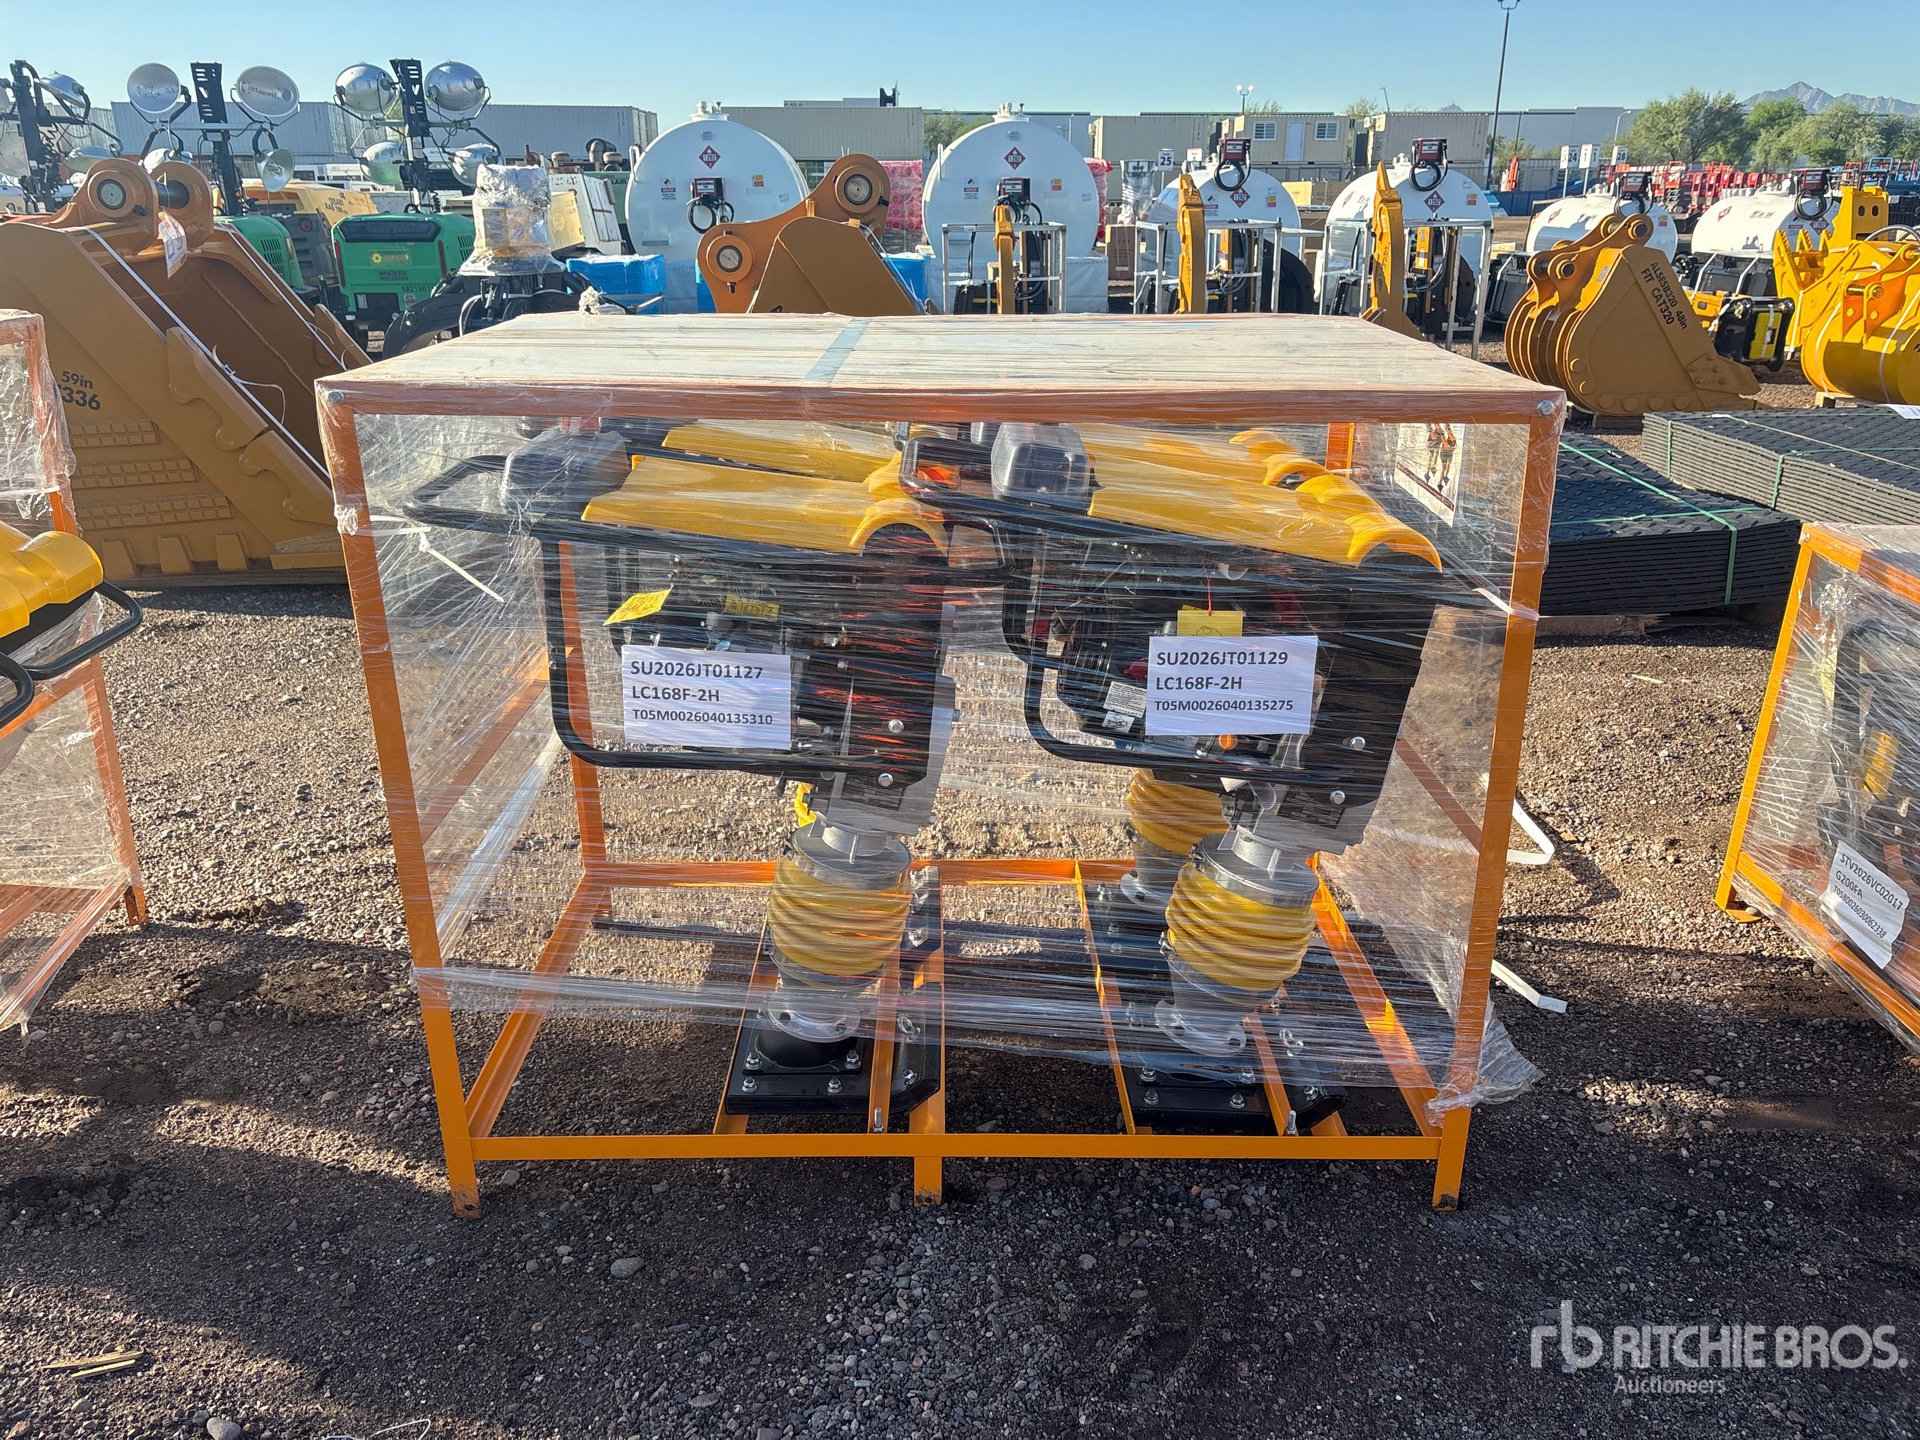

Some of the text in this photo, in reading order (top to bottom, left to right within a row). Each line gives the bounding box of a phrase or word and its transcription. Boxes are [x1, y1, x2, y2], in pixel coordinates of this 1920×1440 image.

[1160, 156, 1172, 166] 25
[1569, 152, 1577, 162] 24
[1617, 152, 1626, 161] 28
[1641, 268, 1675, 325] FIT CAT320
[1650, 261, 1688, 330] ALSESB320 48in
[61, 371, 93, 389] 59in
[55, 384, 101, 411] 336
[1156, 651, 1288, 665] SU2026JT01129
[630, 660, 763, 679] SU2026JT01127
[1156, 676, 1243, 690] LC168F-2H
[632, 686, 720, 702] LC168F-2H
[1155, 700, 1294, 711] T05M0026040135275
[632, 709, 773, 725] T05M0026040135310
[1835, 870, 1863, 900] G200FA
[1839, 853, 1904, 911] STV2026VC02017
